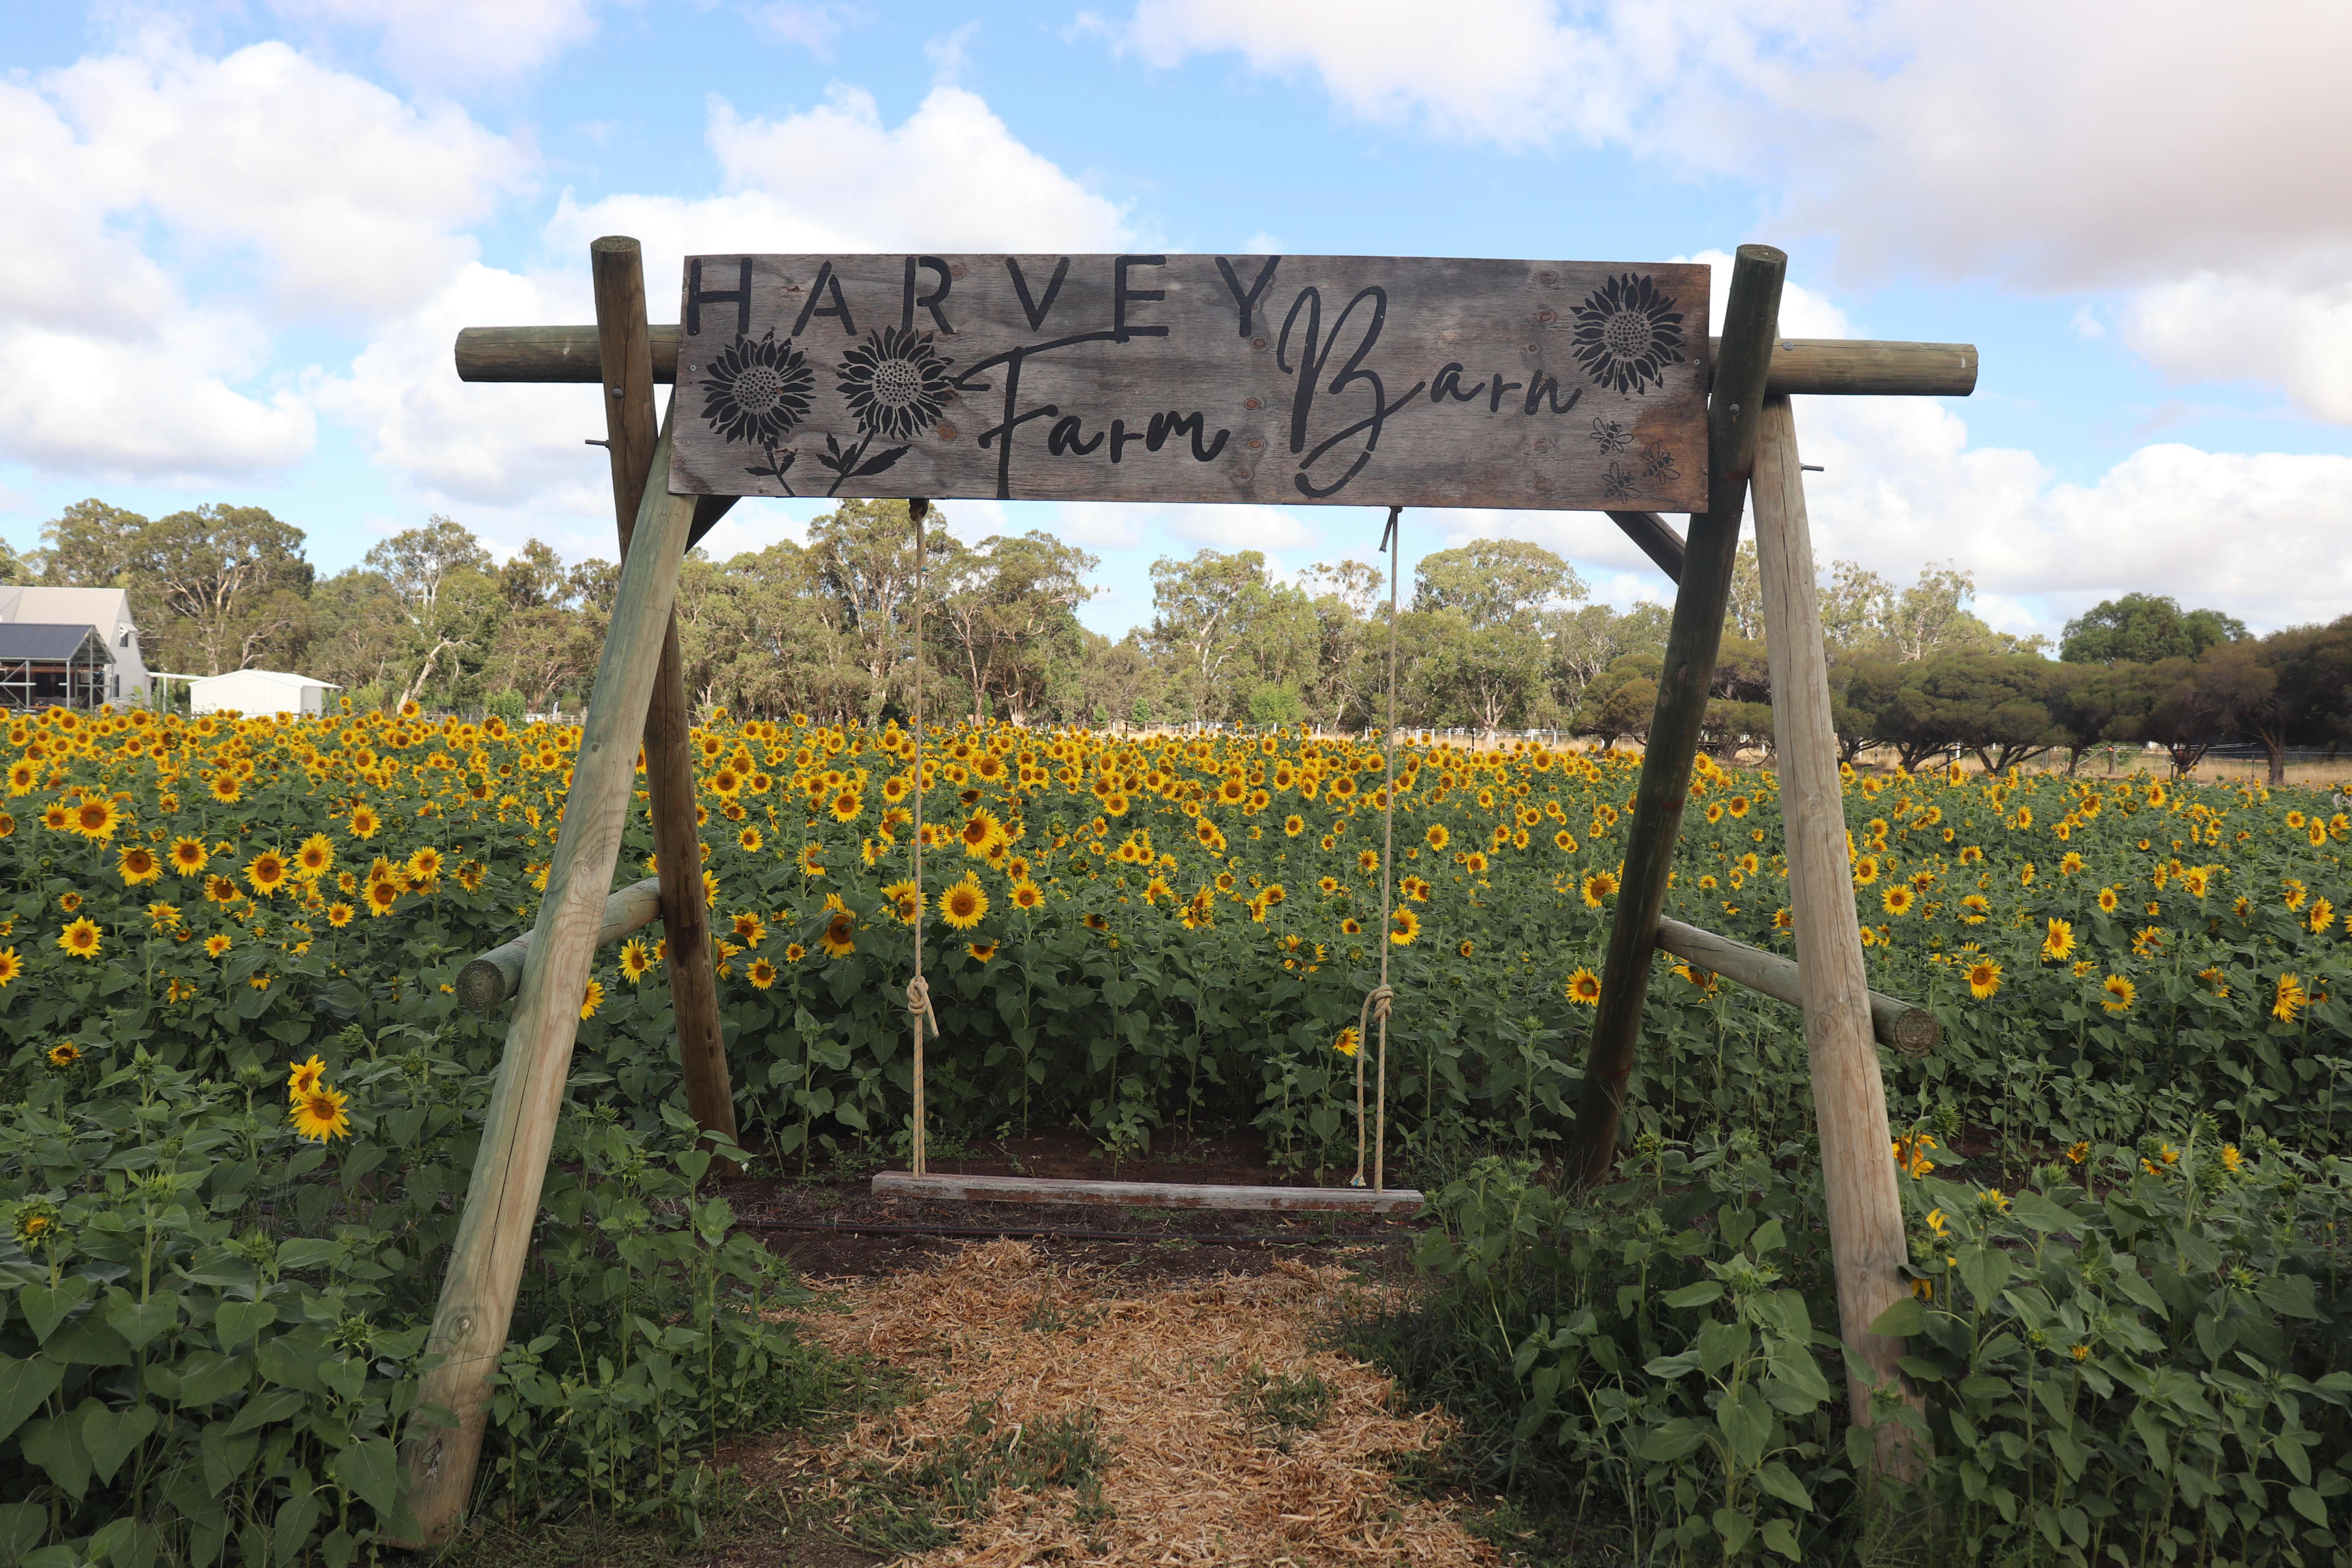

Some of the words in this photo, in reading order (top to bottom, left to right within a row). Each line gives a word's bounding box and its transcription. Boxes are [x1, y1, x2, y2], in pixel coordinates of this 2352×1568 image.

[687, 255, 1281, 337] HARVEY
[948, 330, 1231, 499] Farm
[1276, 285, 1582, 498] Barn
